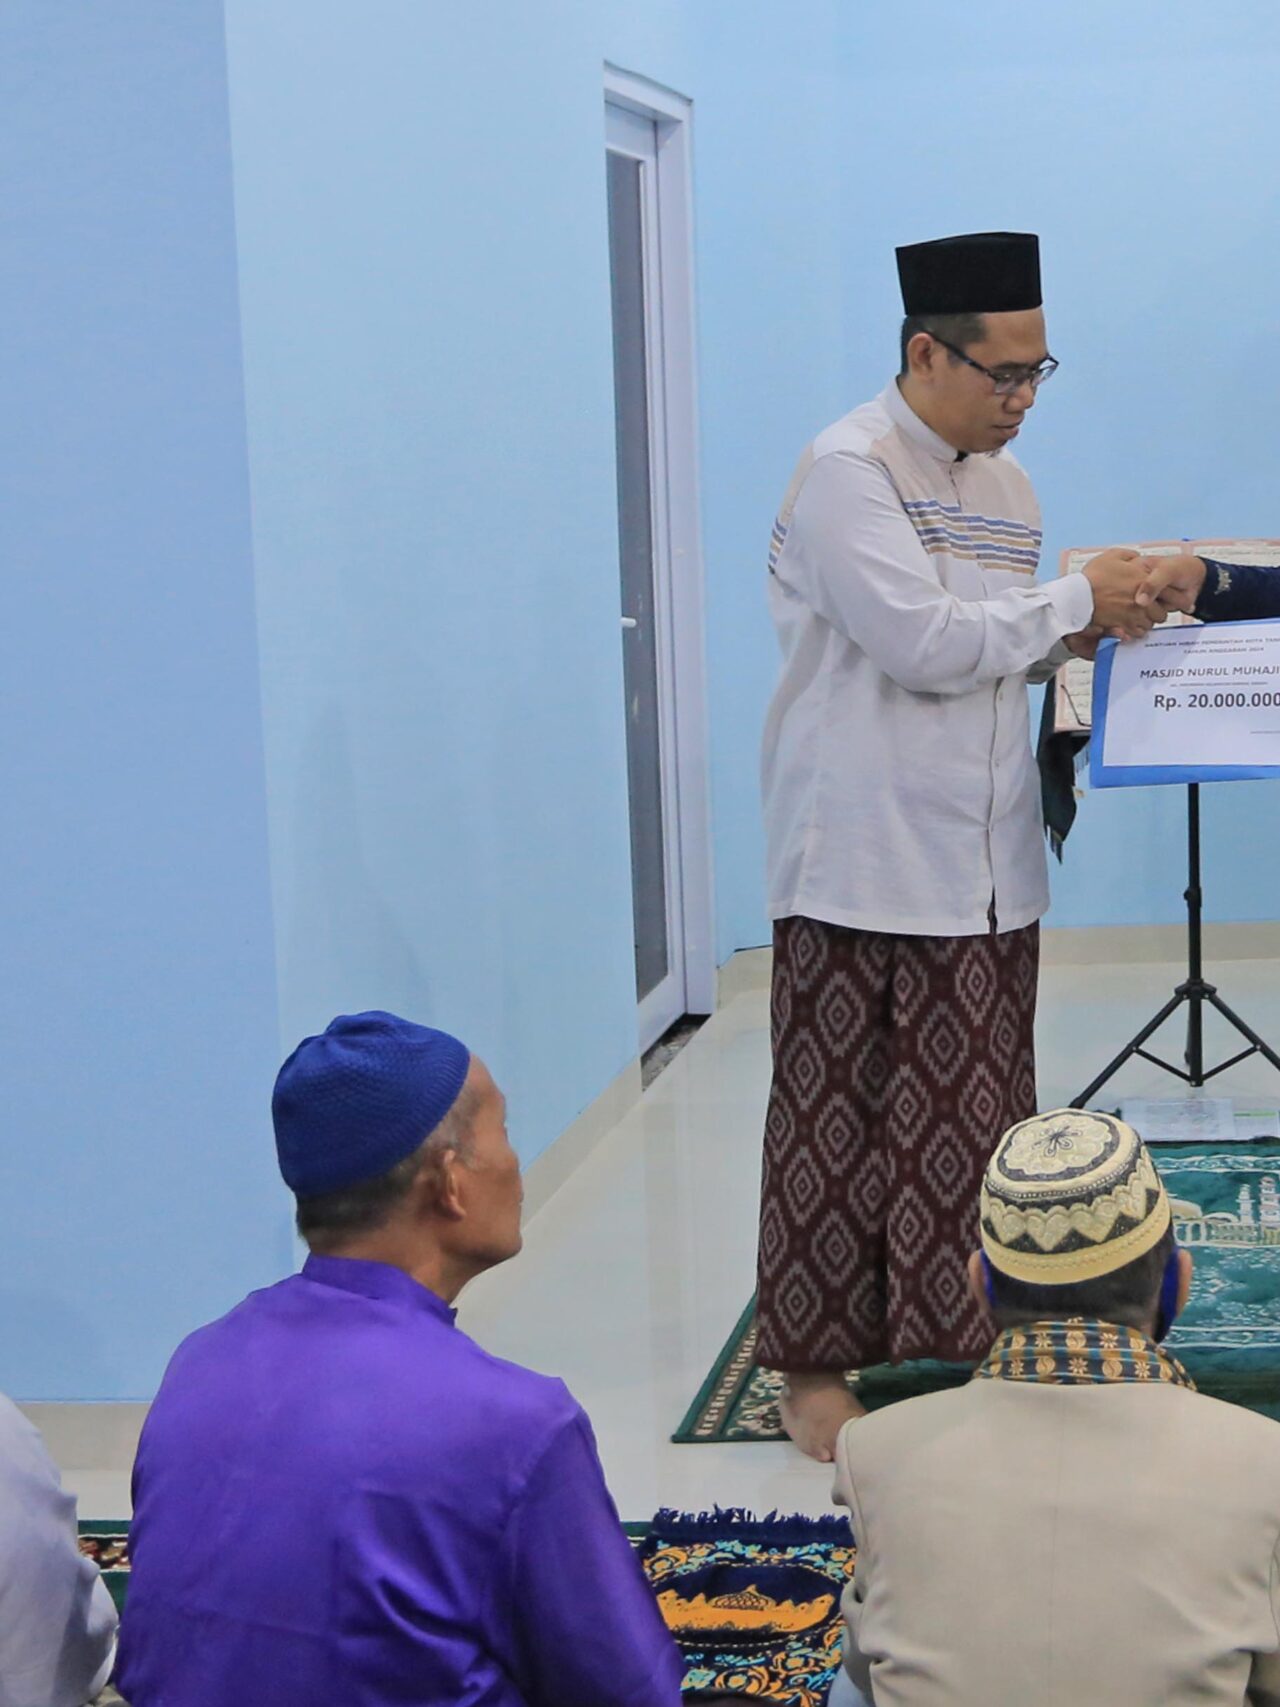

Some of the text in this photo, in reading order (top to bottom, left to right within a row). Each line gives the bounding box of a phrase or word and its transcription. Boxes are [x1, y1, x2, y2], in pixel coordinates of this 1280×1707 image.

[1140, 668, 1184, 678] MASJID
[1187, 667, 1229, 677] NURUL
[1154, 695, 1181, 711] Rp.
